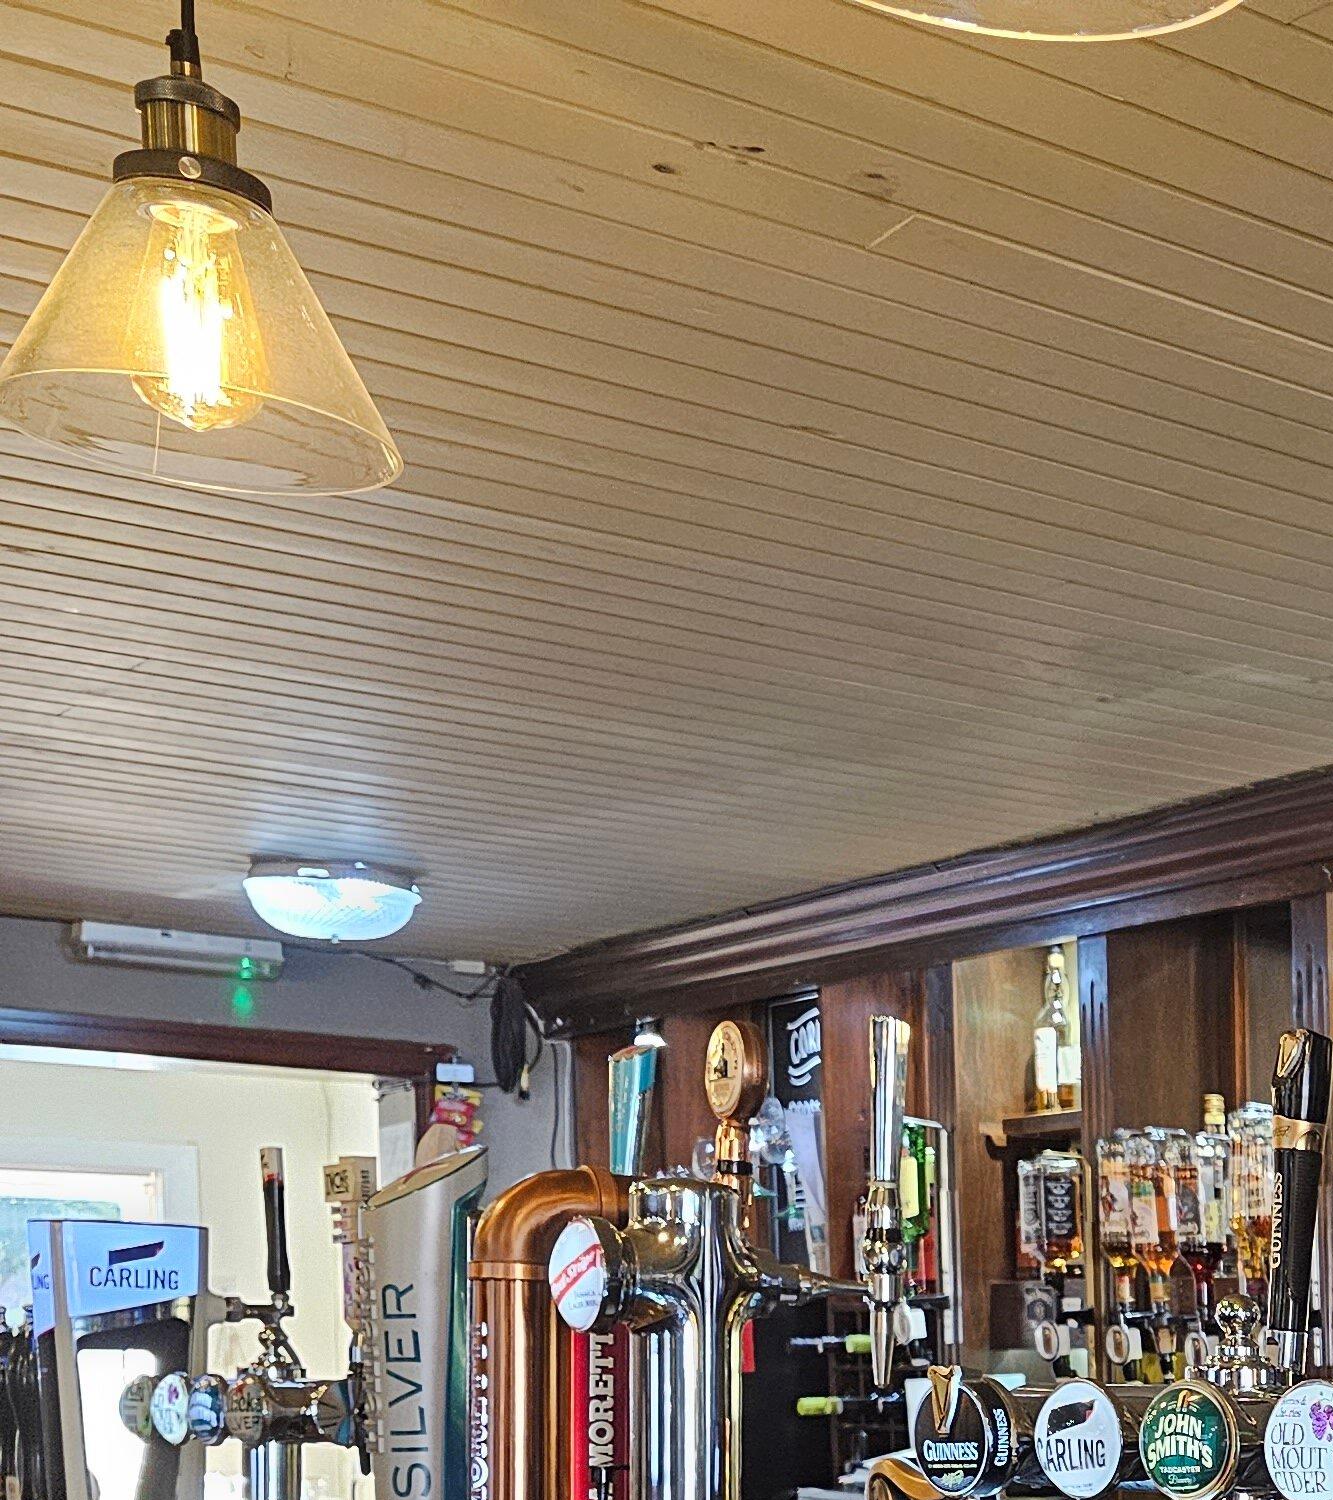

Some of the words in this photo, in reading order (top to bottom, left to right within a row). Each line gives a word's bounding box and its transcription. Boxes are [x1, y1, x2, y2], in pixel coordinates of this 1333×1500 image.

[89, 1266, 179, 1290] CARLING
[382, 1284, 431, 1497] SILVER
[590, 1333, 615, 1467] MORETT
[993, 1408, 1009, 1467] GUINNESS
[1155, 1413, 1203, 1439] JOHN
[1271, 1423, 1304, 1445] OLD
[923, 1440, 979, 1461] GUINNESS
[1037, 1438, 1106, 1472] CARLING
[1147, 1436, 1213, 1470] SMITH'S
[1271, 1446, 1327, 1470] MOUT
[1159, 1465, 1201, 1473] TADCASTER
[1274, 1471, 1329, 1493] CIDER
